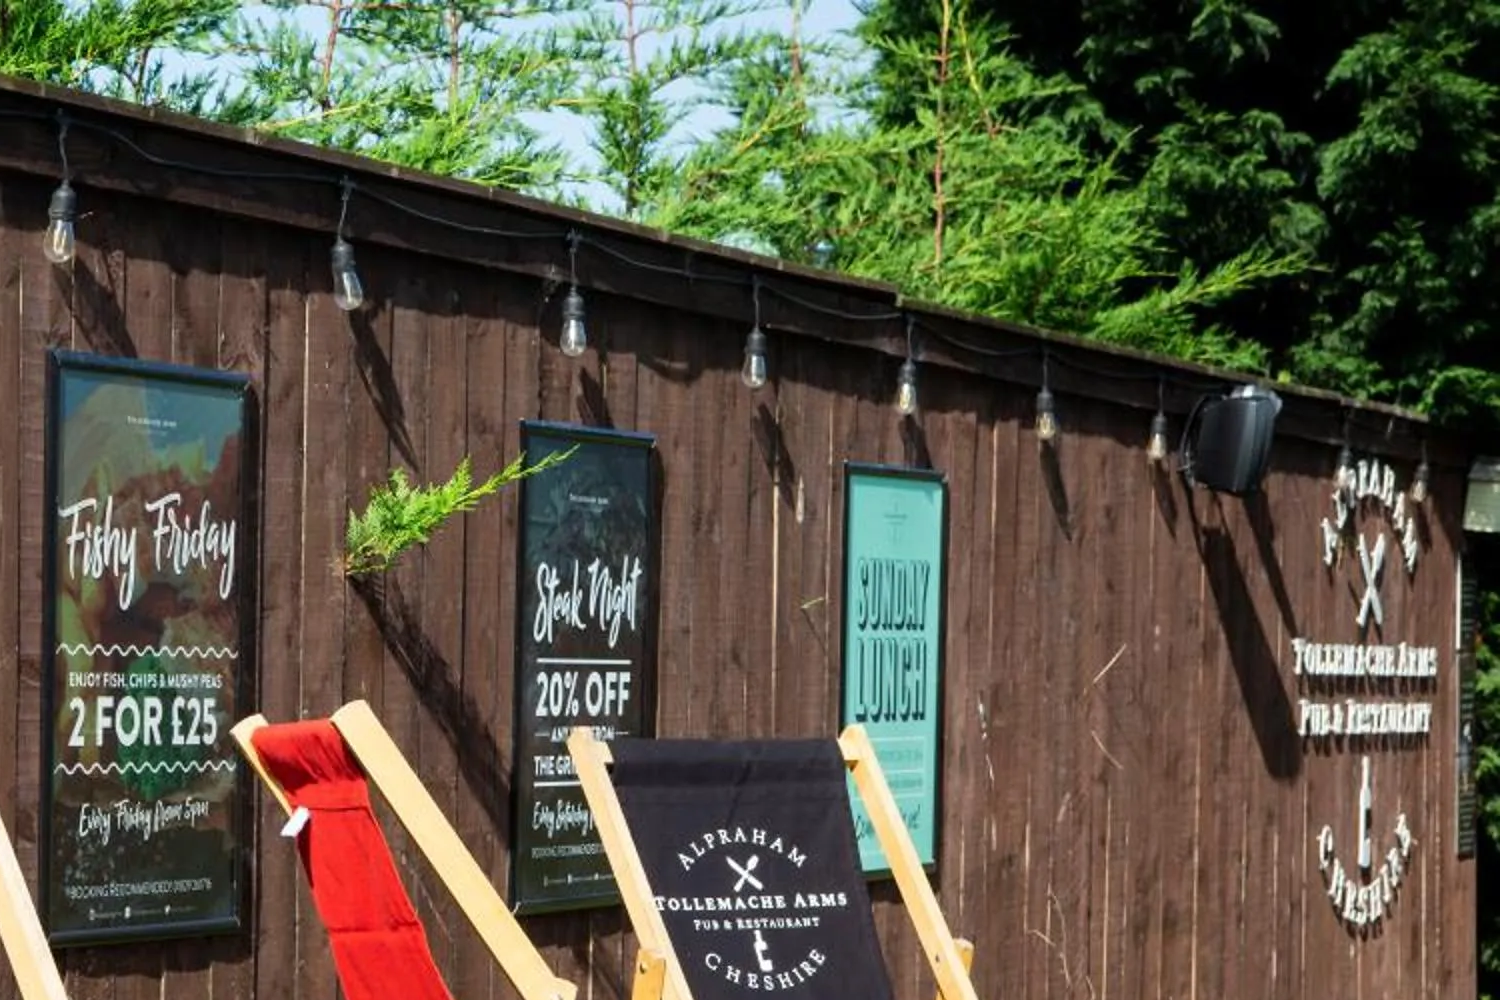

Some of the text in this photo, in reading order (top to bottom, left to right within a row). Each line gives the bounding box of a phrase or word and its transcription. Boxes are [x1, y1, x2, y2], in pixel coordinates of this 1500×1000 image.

[57, 492, 237, 611] Fishy Friday
[533, 554, 643, 649] Steak Night
[858, 557, 931, 631] SUNDAY
[1292, 637, 1438, 677] TOLLEMACHE ARMS
[68, 671, 100, 688] ENJOY
[129, 673, 158, 689] CHIPS
[167, 674, 199, 689] MUSHY
[201, 674, 223, 689] PEAS
[535, 671, 632, 717] 20% OFF
[855, 637, 928, 723] LUNCH
[67, 695, 219, 747] 2 FOR £25
[1298, 699, 1331, 736] PUB
[1345, 698, 1433, 734] RESTAURANT
[533, 755, 555, 776] THE
[114, 798, 152, 841] Friday
[677, 827, 808, 871] ALPRAHAM
[1316, 813, 1411, 926] CHESHIRE
[654, 892, 848, 911] TOLLEMACHE ARMS
[693, 917, 821, 931] PUB & RESTAURANT
[705, 949, 827, 991] CHESHIRE
